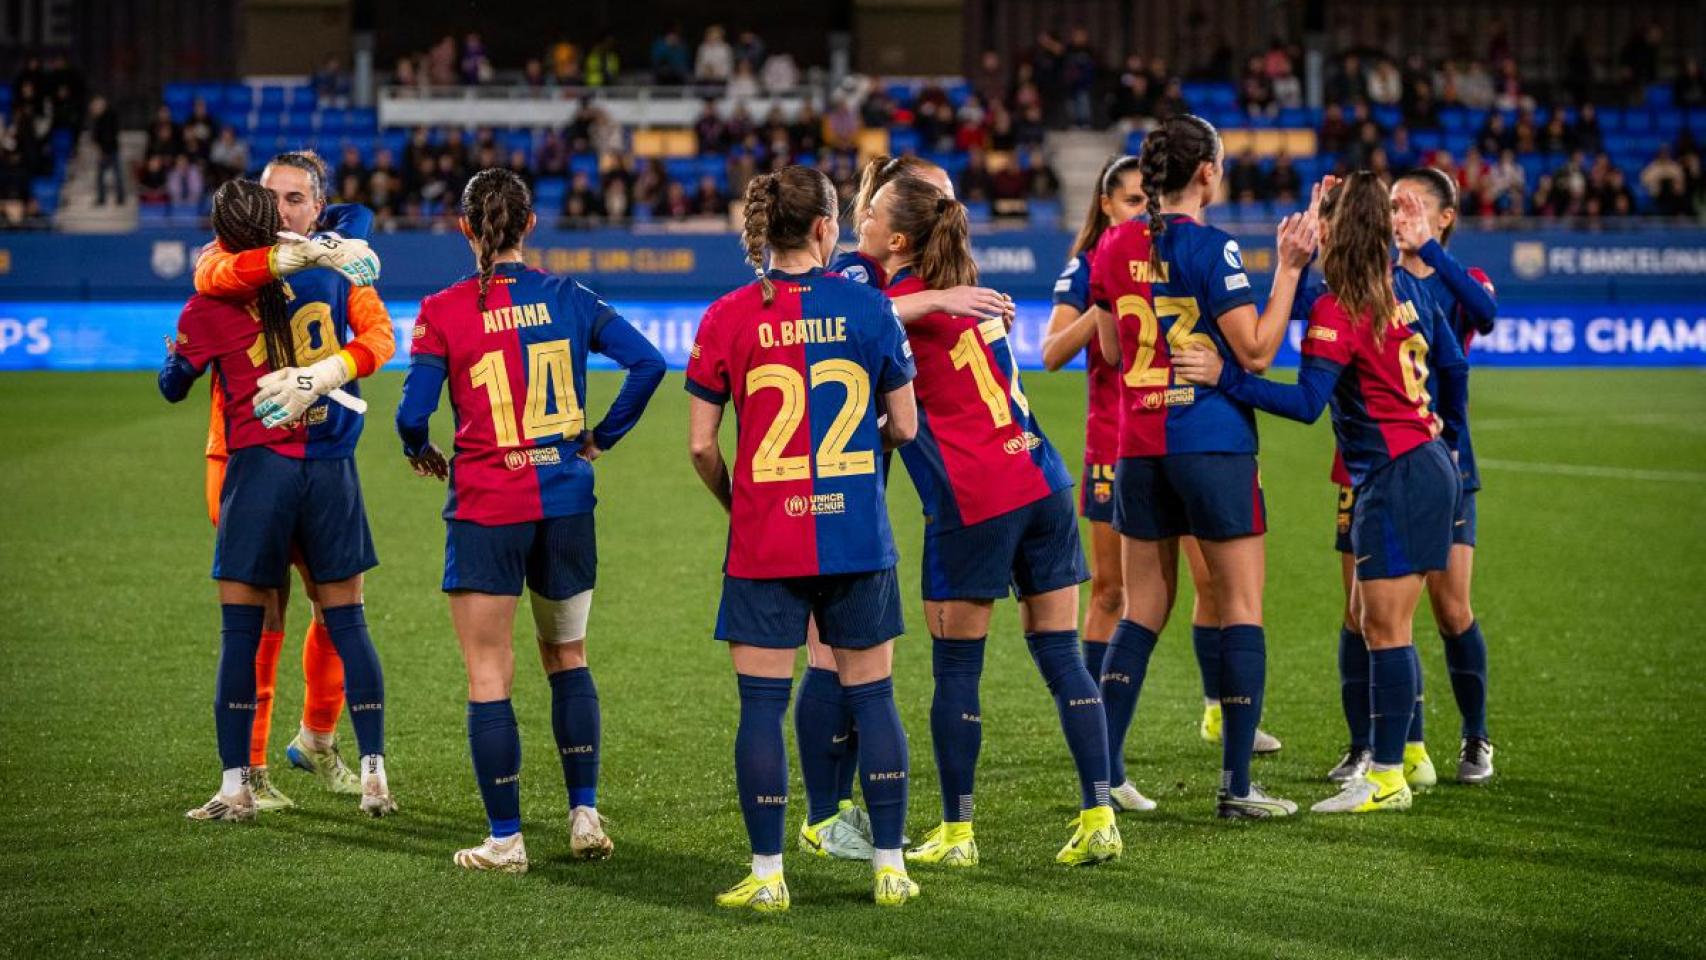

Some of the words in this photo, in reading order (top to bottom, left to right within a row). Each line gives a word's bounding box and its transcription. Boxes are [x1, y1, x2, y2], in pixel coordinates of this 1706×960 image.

[482, 302, 552, 334] AITANA
[1116, 294, 1218, 388] 23
[1584, 316, 1706, 354] CHAM
[469, 338, 585, 448] 14
[949, 316, 1029, 428] 17
[745, 358, 876, 483] 22
[810, 493, 844, 502] UNHCR
[810, 501, 845, 511] ACNUR
